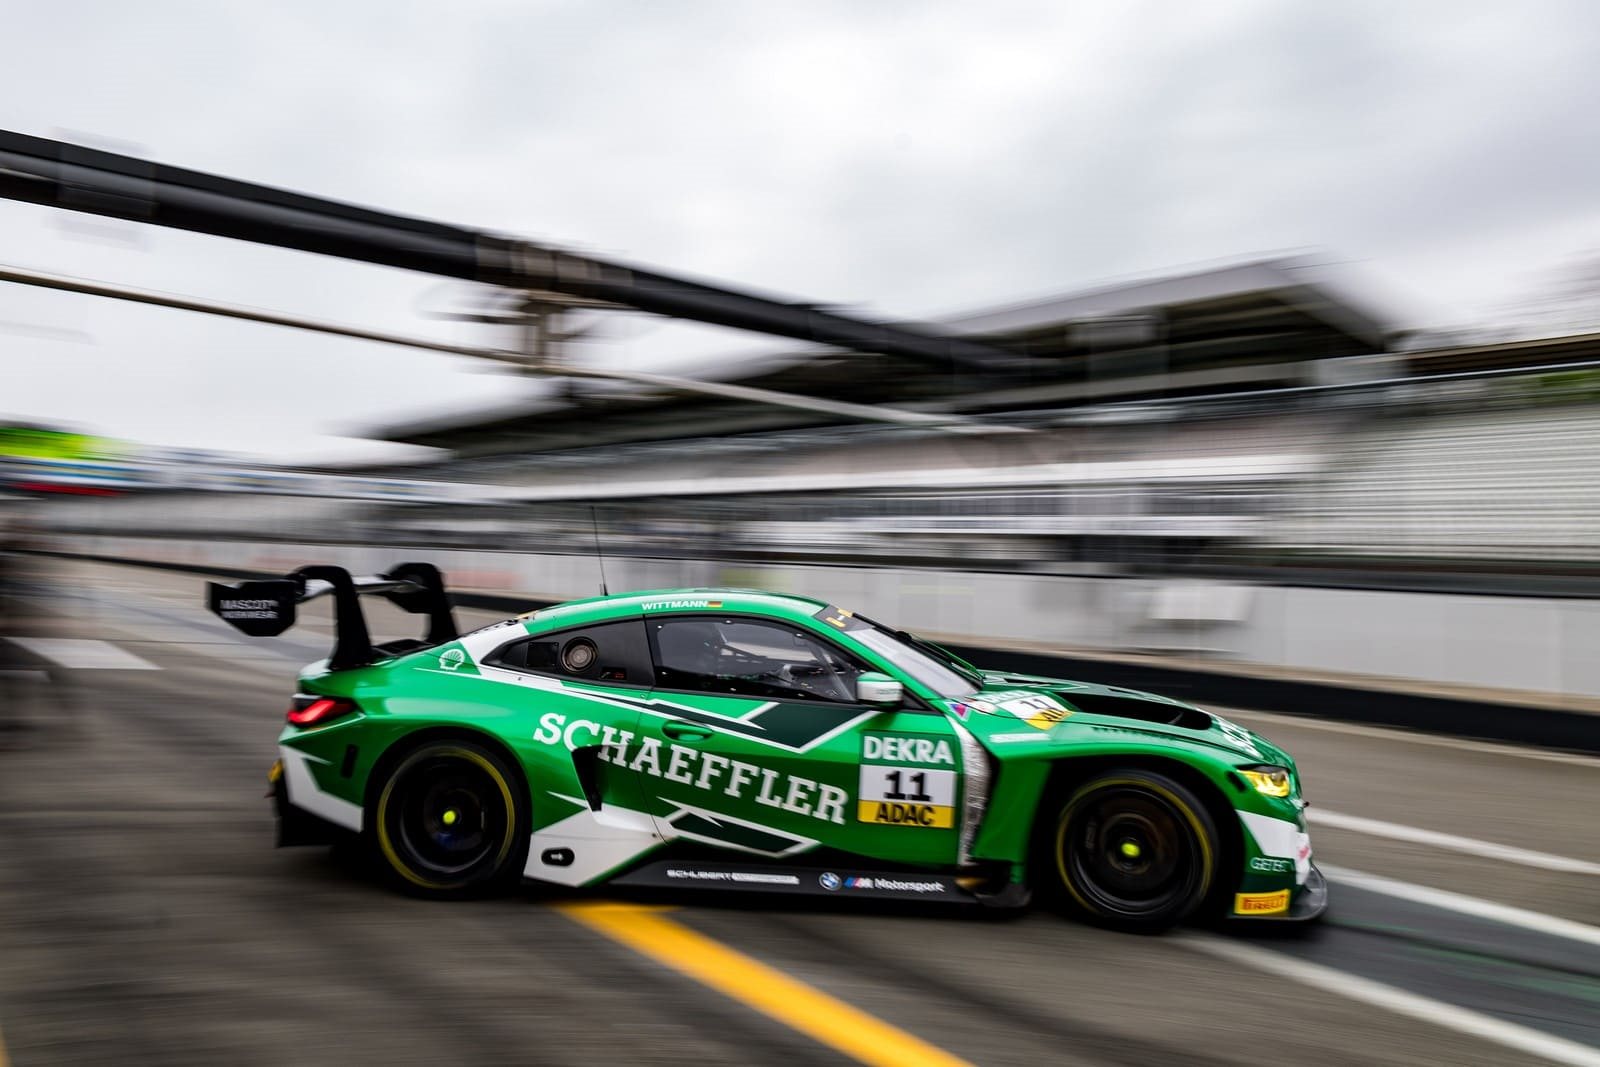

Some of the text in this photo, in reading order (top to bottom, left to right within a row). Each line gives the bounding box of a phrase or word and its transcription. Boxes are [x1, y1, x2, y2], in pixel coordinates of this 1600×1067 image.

[641, 600, 708, 611] WITTMANN
[863, 735, 955, 765] DEKRA
[533, 712, 849, 825] SCHAEFFLER
[884, 770, 932, 802] 11
[875, 803, 935, 826] ADAC
[874, 878, 945, 893] Motorsport
